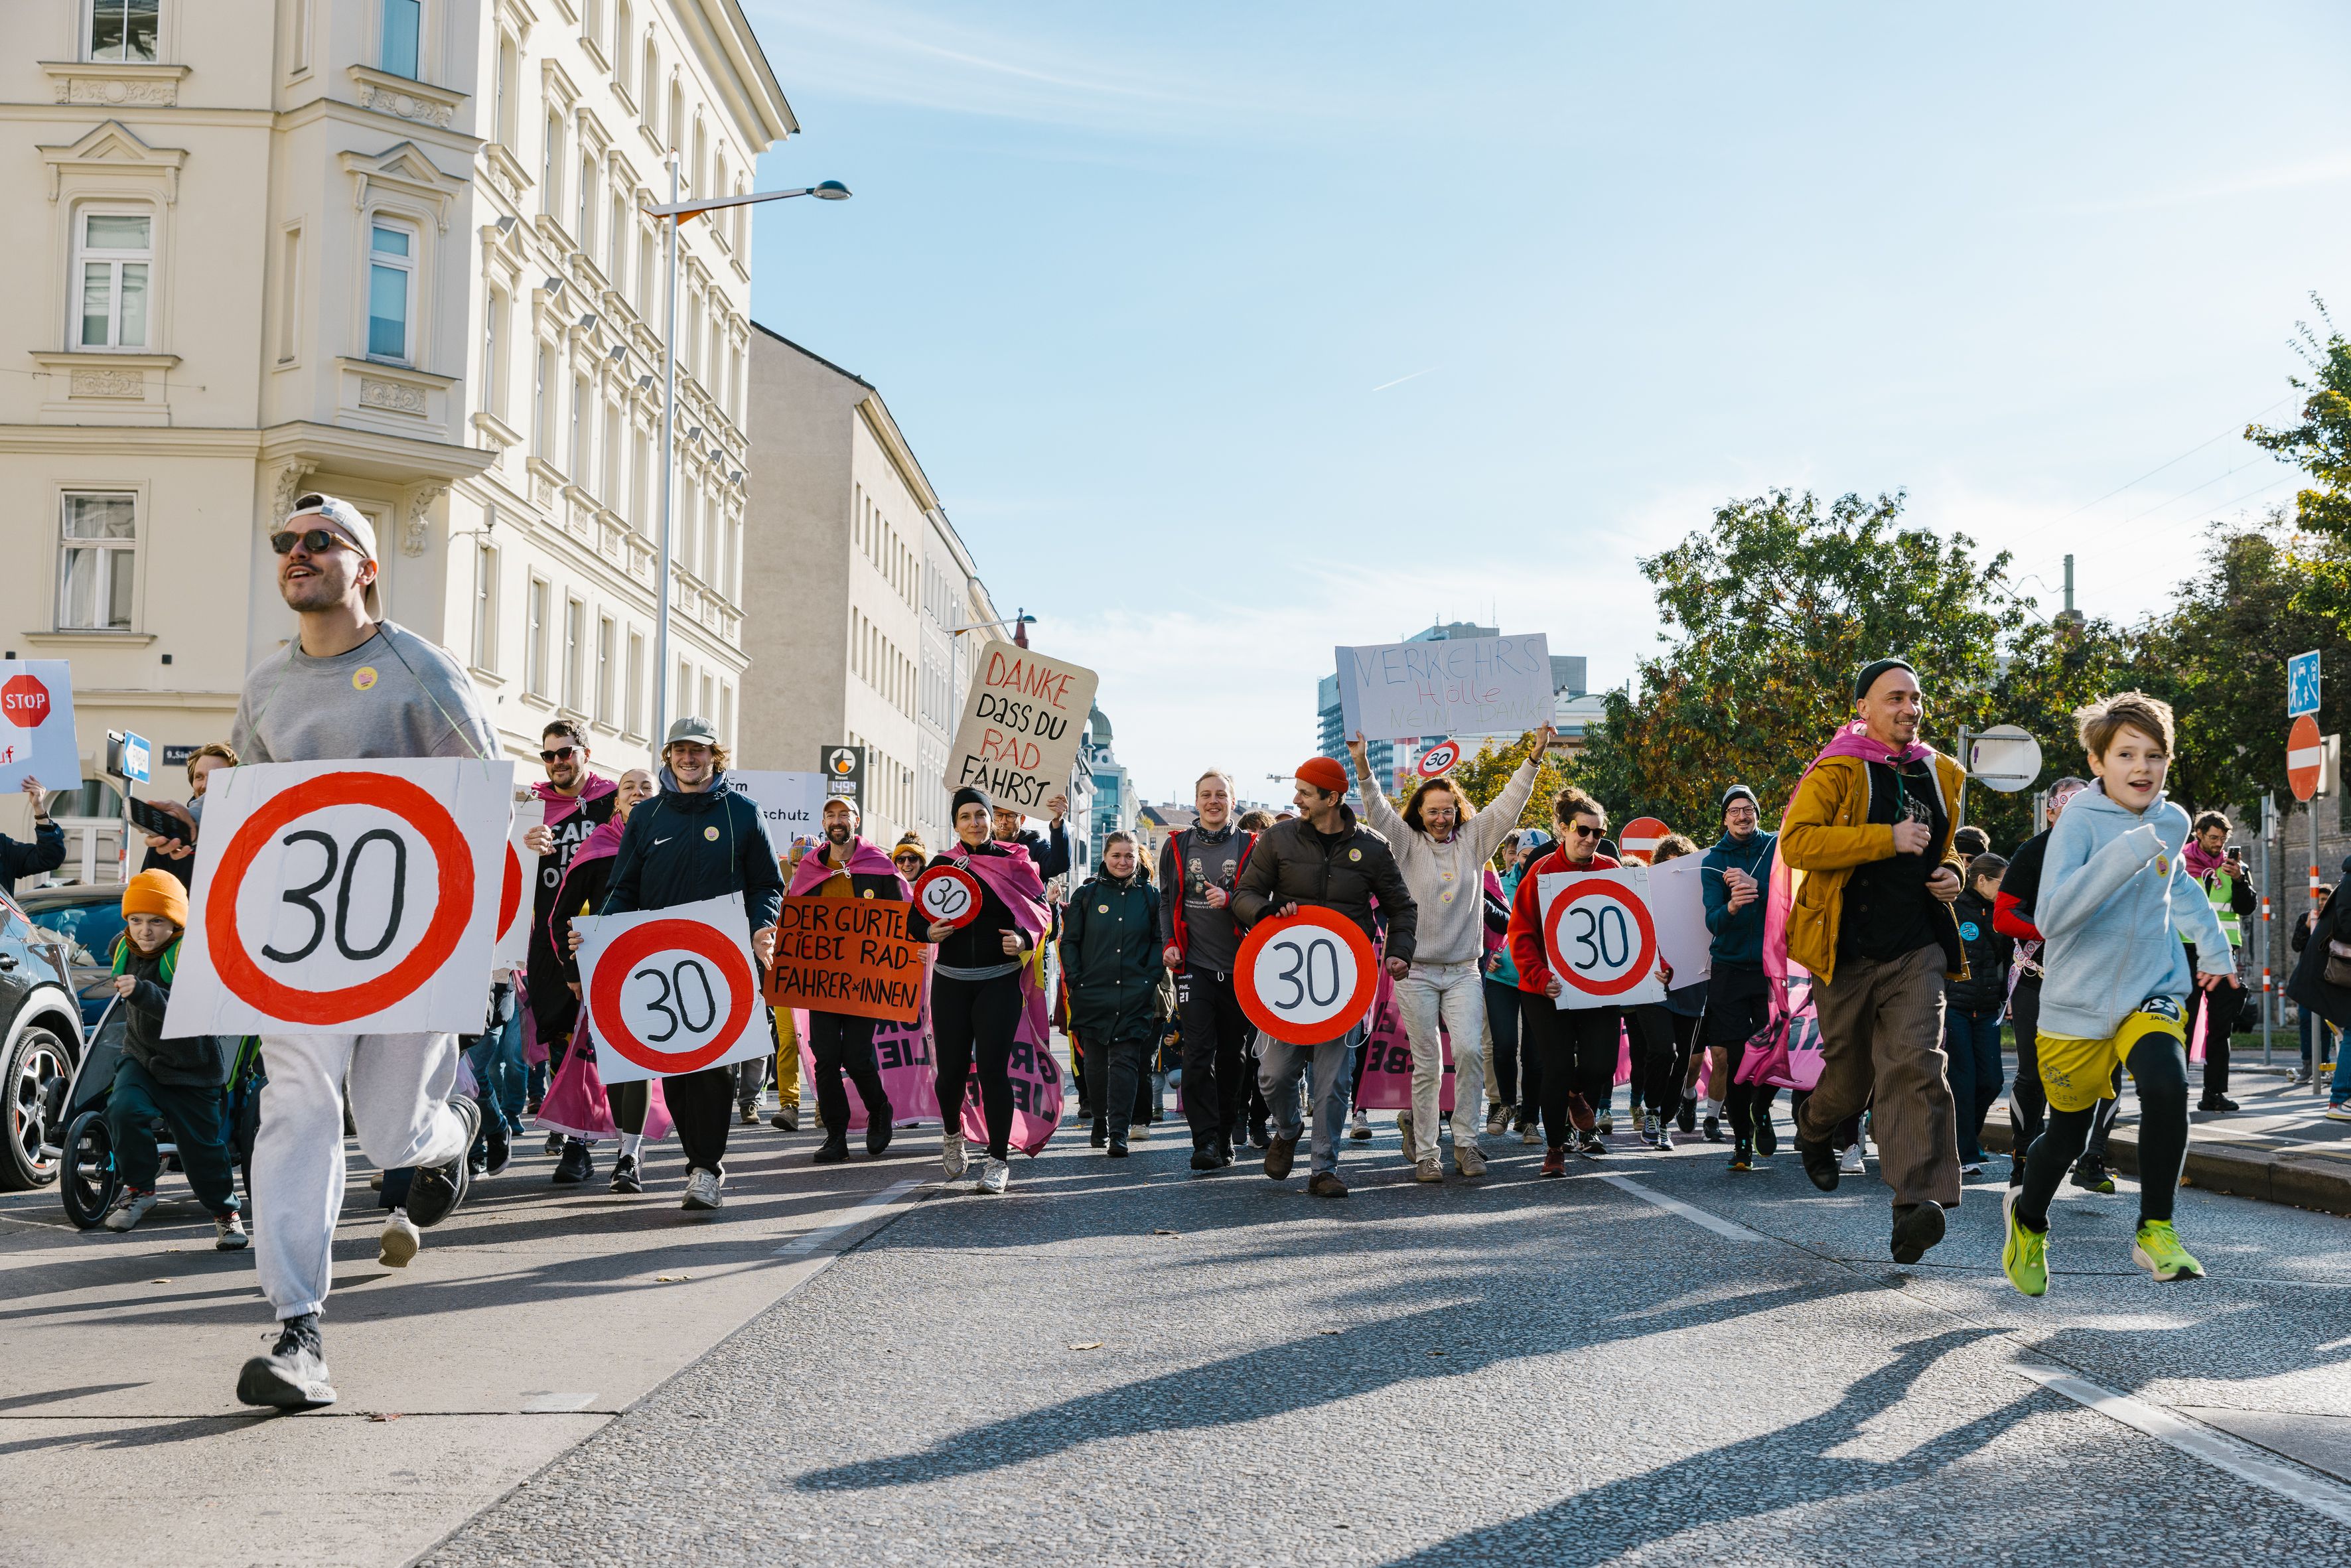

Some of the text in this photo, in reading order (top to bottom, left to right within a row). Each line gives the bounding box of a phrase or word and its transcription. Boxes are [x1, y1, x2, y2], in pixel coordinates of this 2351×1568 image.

[1354, 639, 1540, 687] VERKEHRS
[985, 651, 1076, 711] DANKE
[1415, 679, 1501, 706] Hölle
[5, 693, 46, 709] STOP
[1390, 695, 1551, 729] NEIN DANKE
[1034, 711, 1068, 741] DU
[979, 728, 1040, 770] RAD
[1425, 752, 1451, 766] 30
[960, 754, 1051, 808] FÄHRST
[549, 820, 597, 845] CAR
[261, 828, 407, 963] 30
[928, 878, 967, 914] 30
[780, 904, 829, 931] DER
[860, 939, 918, 970] RAD-
[1569, 905, 1629, 970] 30
[1273, 938, 1340, 1010] 30
[634, 960, 716, 1042] 30
[1179, 991, 1189, 1003] 21
[2149, 1015, 2173, 1025] JAKO
